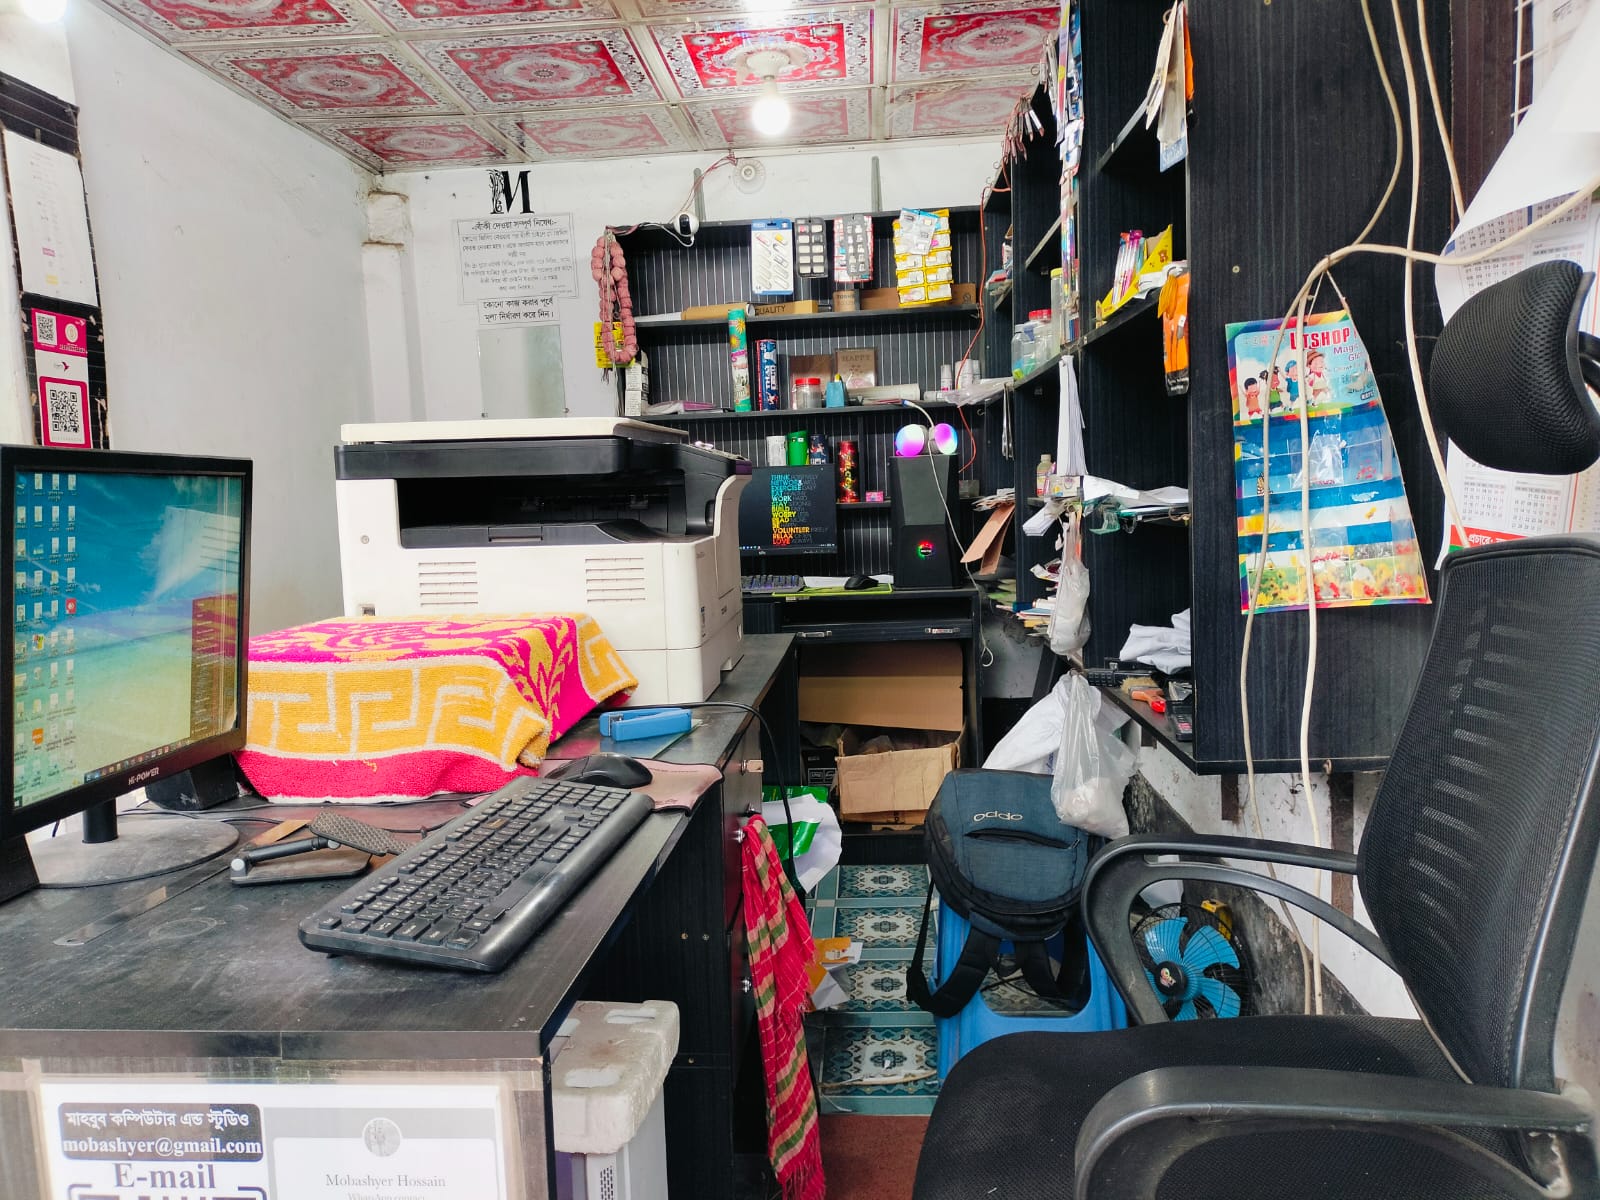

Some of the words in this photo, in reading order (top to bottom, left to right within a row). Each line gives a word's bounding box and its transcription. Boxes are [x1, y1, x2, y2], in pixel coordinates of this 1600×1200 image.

[974, 810, 1023, 822] oddo
[65, 1112, 107, 1129] মাহবুব
[109, 1109, 176, 1127] কম্পিউটার
[180, 1111, 203, 1126] এন্ড
[206, 1109, 249, 1131] স্টুডিও
[63, 1137, 263, 1157] mobashyer@gmail.com
[113, 1162, 216, 1189] E-mail
[326, 1174, 394, 1189] Mobashyer
[397, 1175, 446, 1187] Hossain
